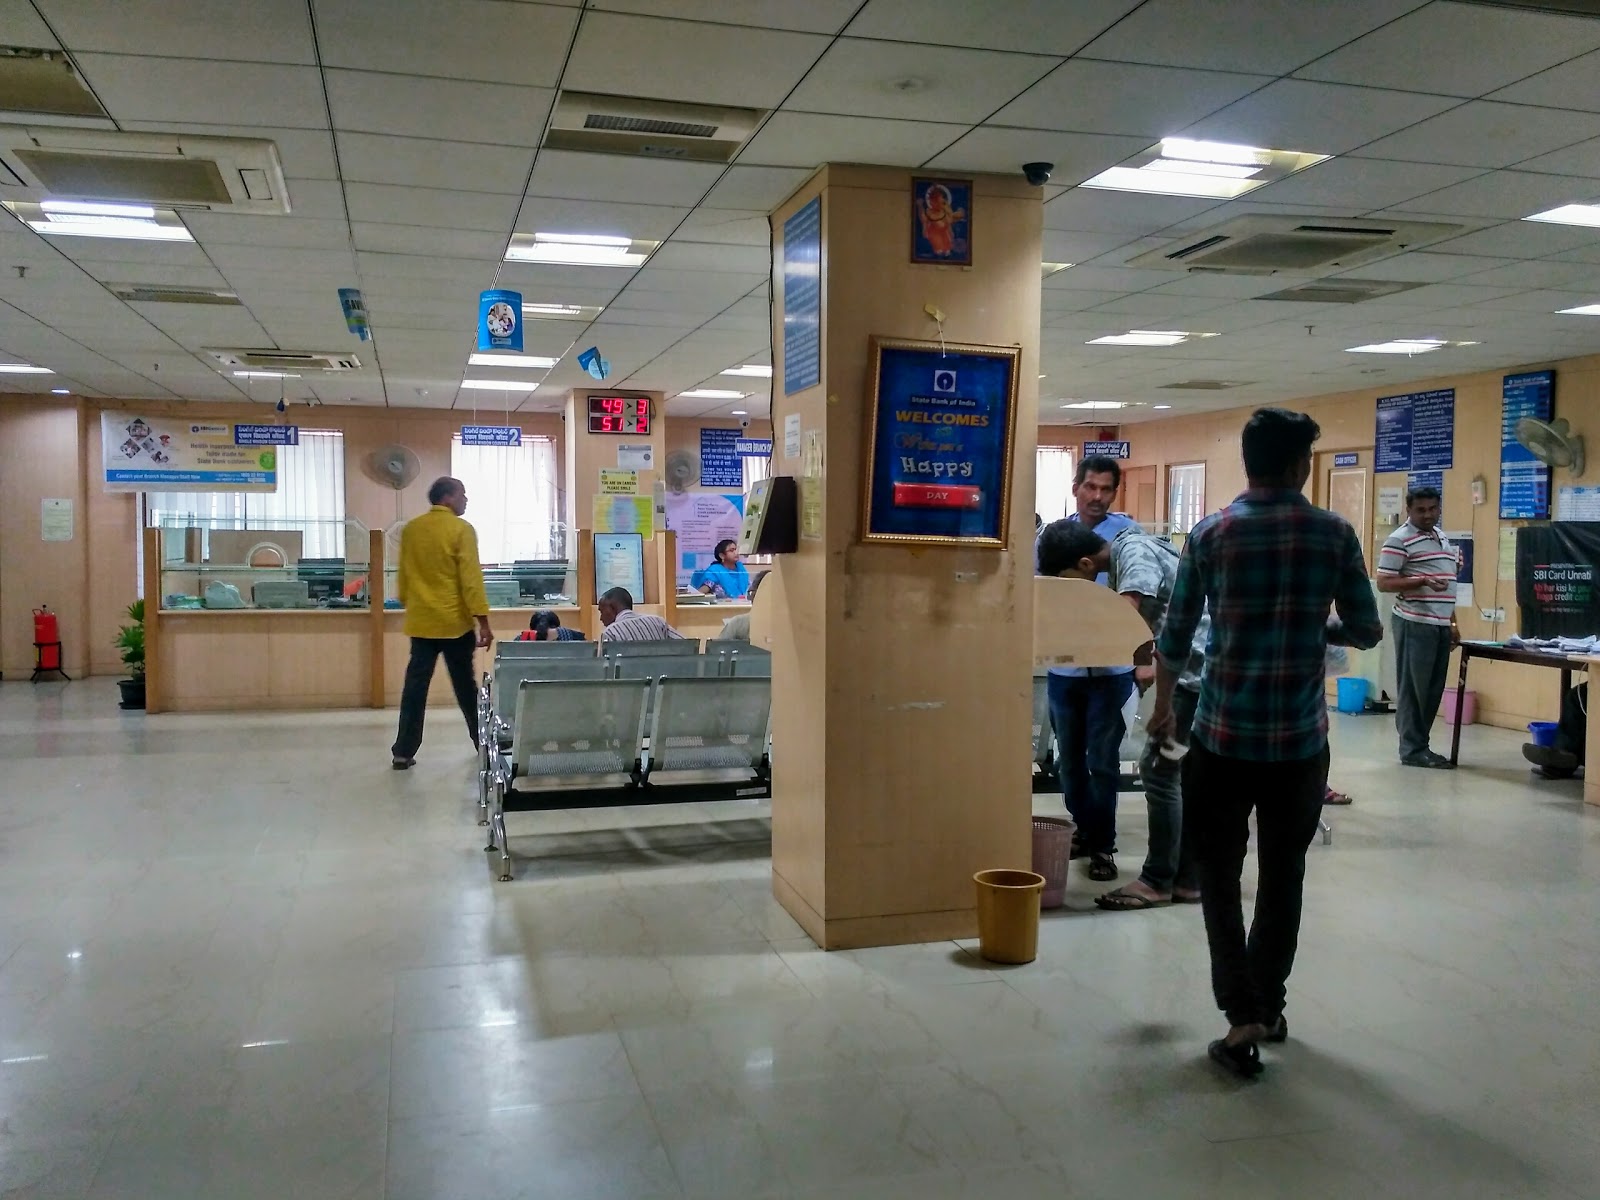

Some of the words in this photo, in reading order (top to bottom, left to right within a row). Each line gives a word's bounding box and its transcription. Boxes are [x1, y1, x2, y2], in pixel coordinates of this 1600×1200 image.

[602, 398, 623, 414] 49
[638, 399, 646, 414] 3
[602, 416, 623, 432] 51
[636, 418, 647, 432] 2
[896, 410, 989, 426] WELCOMES
[287, 427, 294, 444] 1
[509, 429, 518, 445] 2
[737, 443, 752, 452] MANAGER
[1120, 443, 1128, 458] 4
[900, 456, 973, 477] Happy
[926, 492, 948, 500] DAY
[1534, 570, 1546, 580] SBI
[1548, 570, 1565, 580] Card
[1567, 570, 1592, 580] Unnati
[1556, 583, 1567, 592] kisi
[1568, 583, 1576, 592] ke
[1554, 592, 1572, 600] credit
